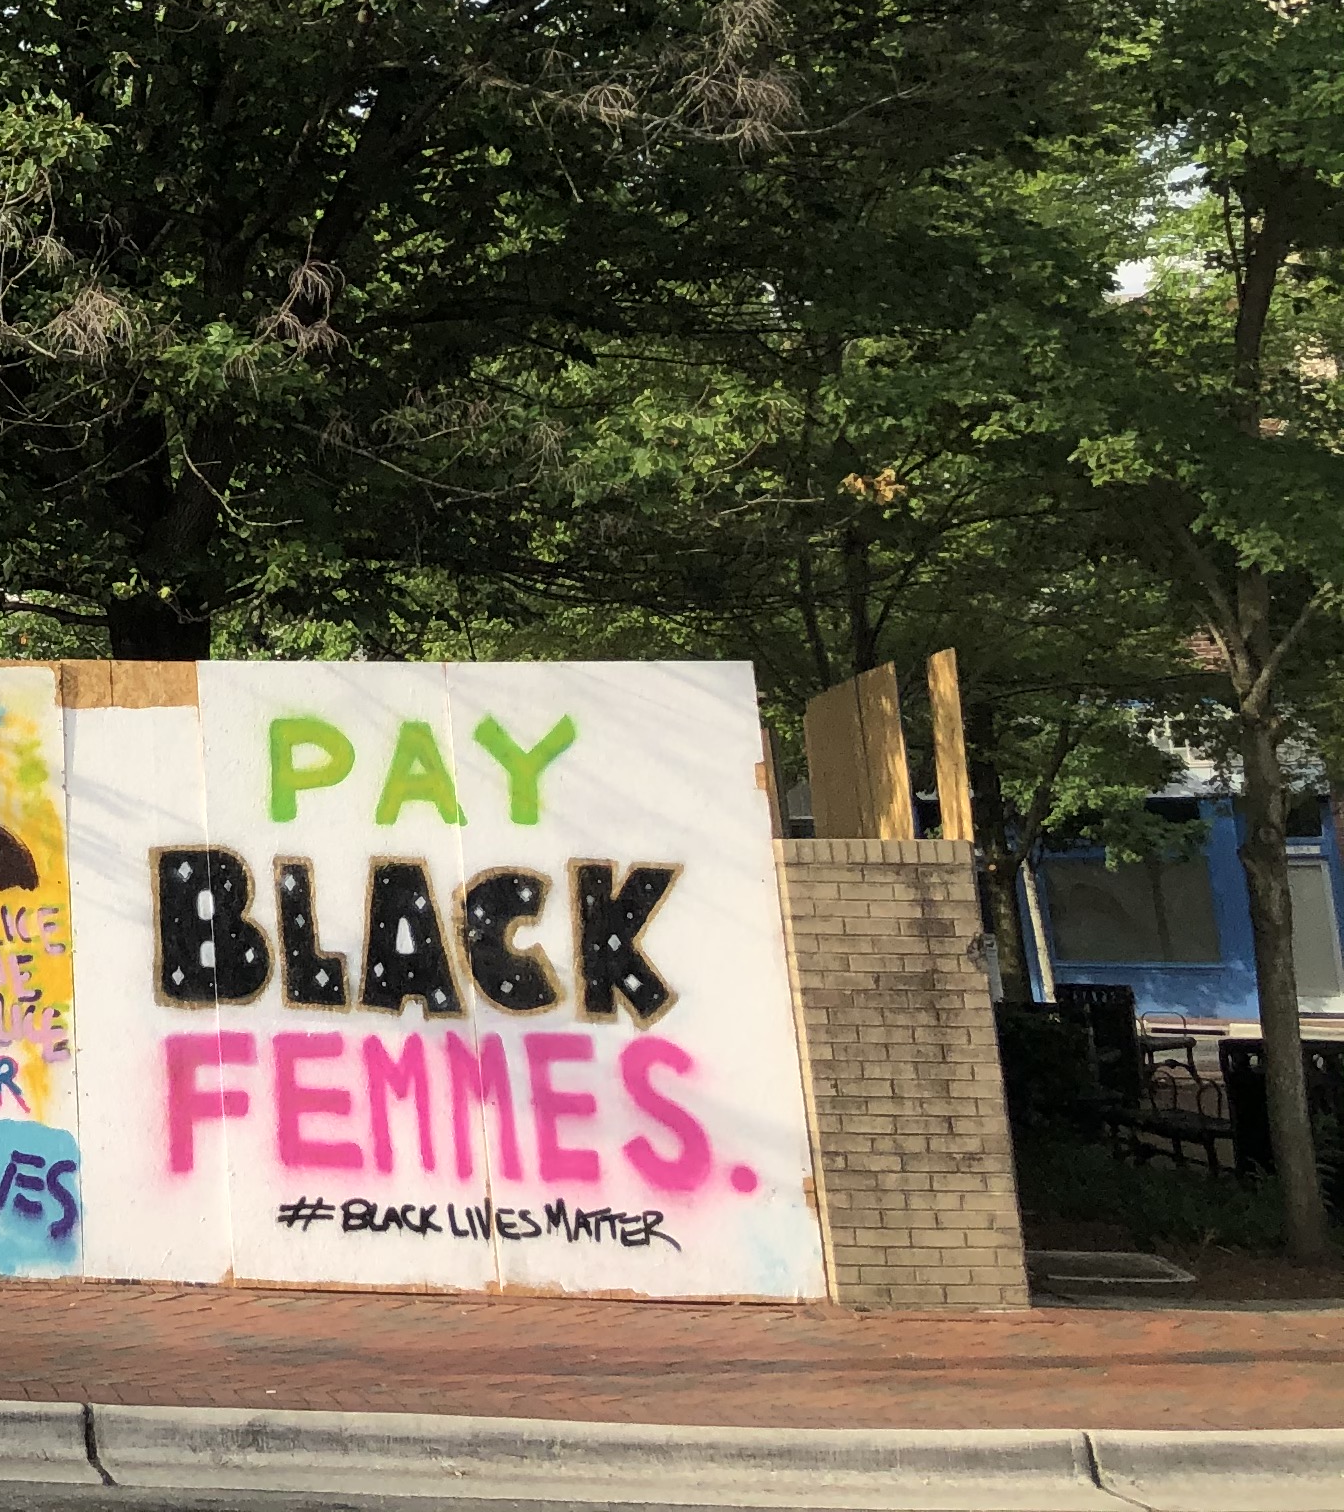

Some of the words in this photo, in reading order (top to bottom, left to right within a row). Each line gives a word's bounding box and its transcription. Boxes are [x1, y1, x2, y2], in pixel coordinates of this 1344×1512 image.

[267, 713, 578, 826] PAY
[148, 844, 684, 1031] BLACK
[163, 1030, 761, 1194] FEMMES.
